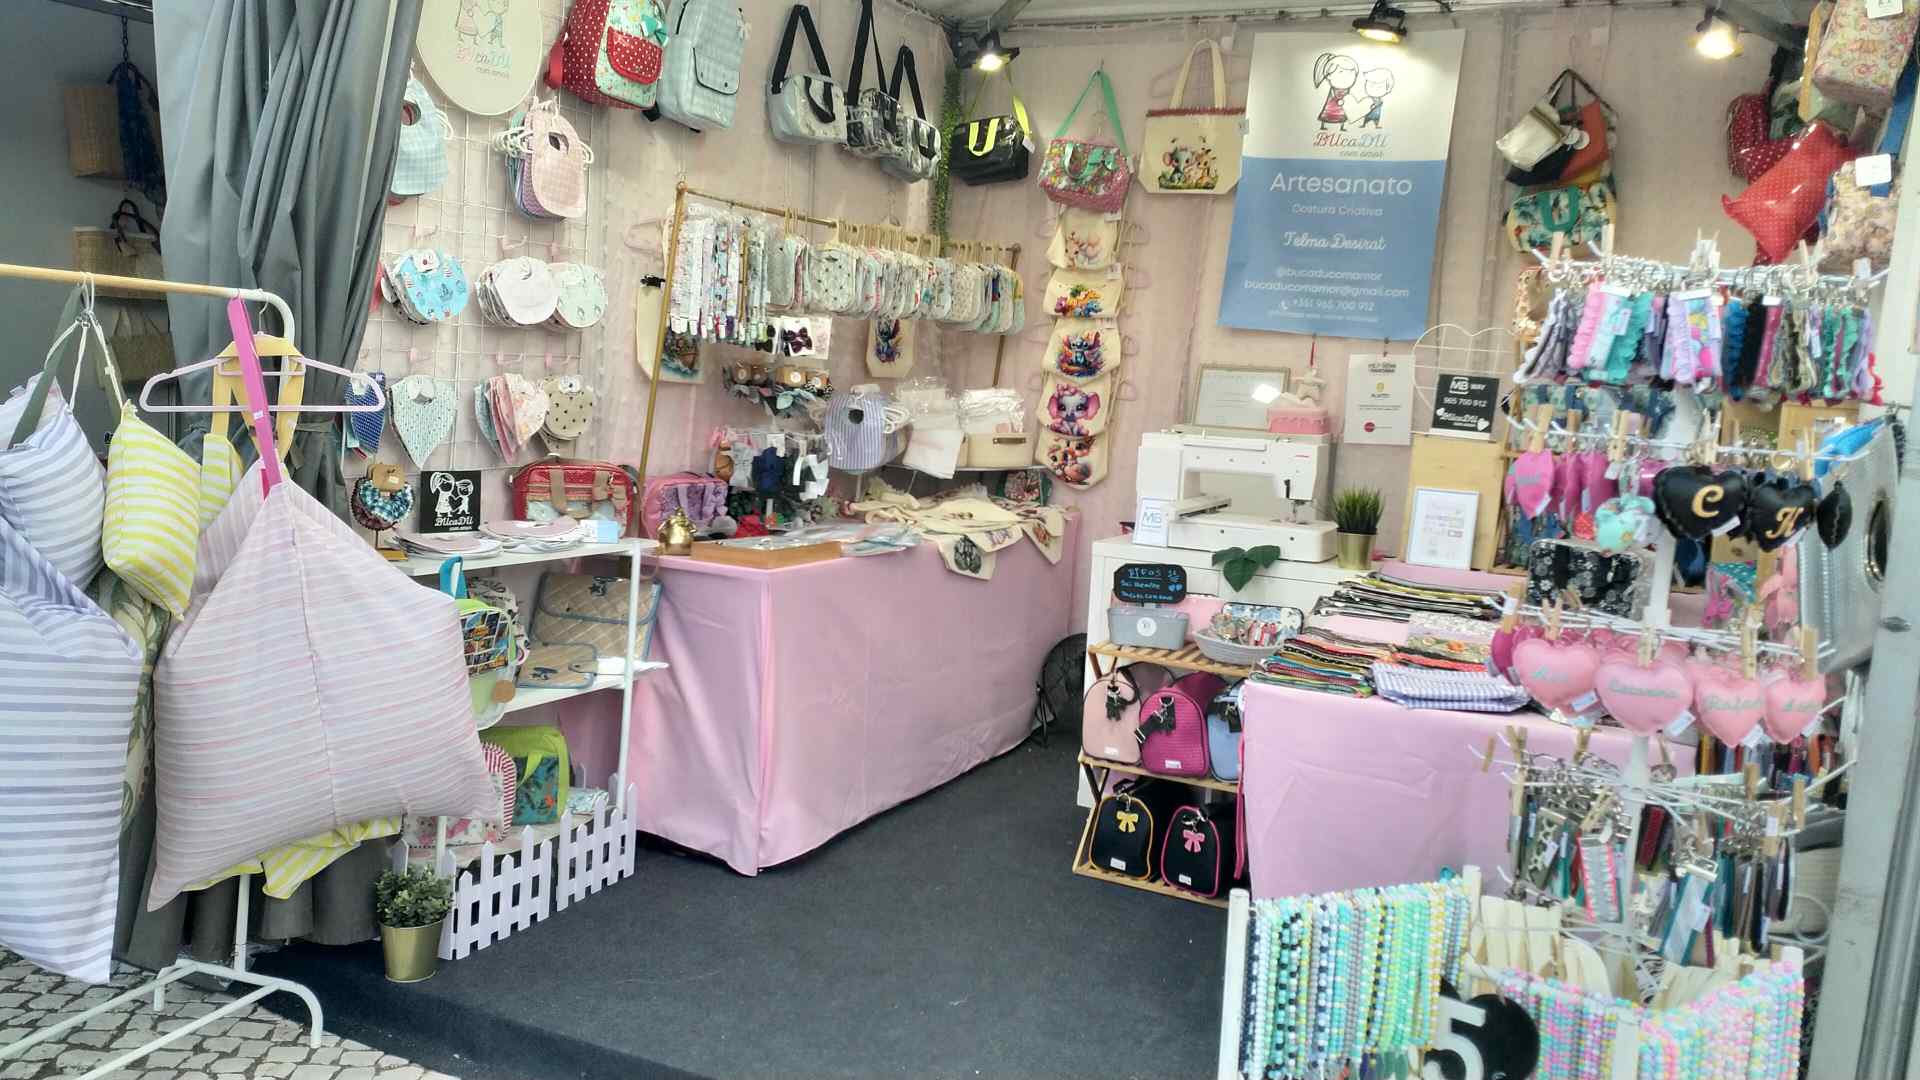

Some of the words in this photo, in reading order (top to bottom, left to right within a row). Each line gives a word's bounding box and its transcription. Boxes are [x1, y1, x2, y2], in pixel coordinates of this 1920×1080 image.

[1269, 171, 1413, 196] Artesanato
[1291, 203, 1336, 215] Costura
[1338, 205, 1383, 217] Criativa
[1283, 231, 1328, 248] Telma
[1244, 279, 1409, 297] bucaducomamor@gmail.com
[1357, 300, 1375, 312] 912
[1691, 484, 1725, 519] C
